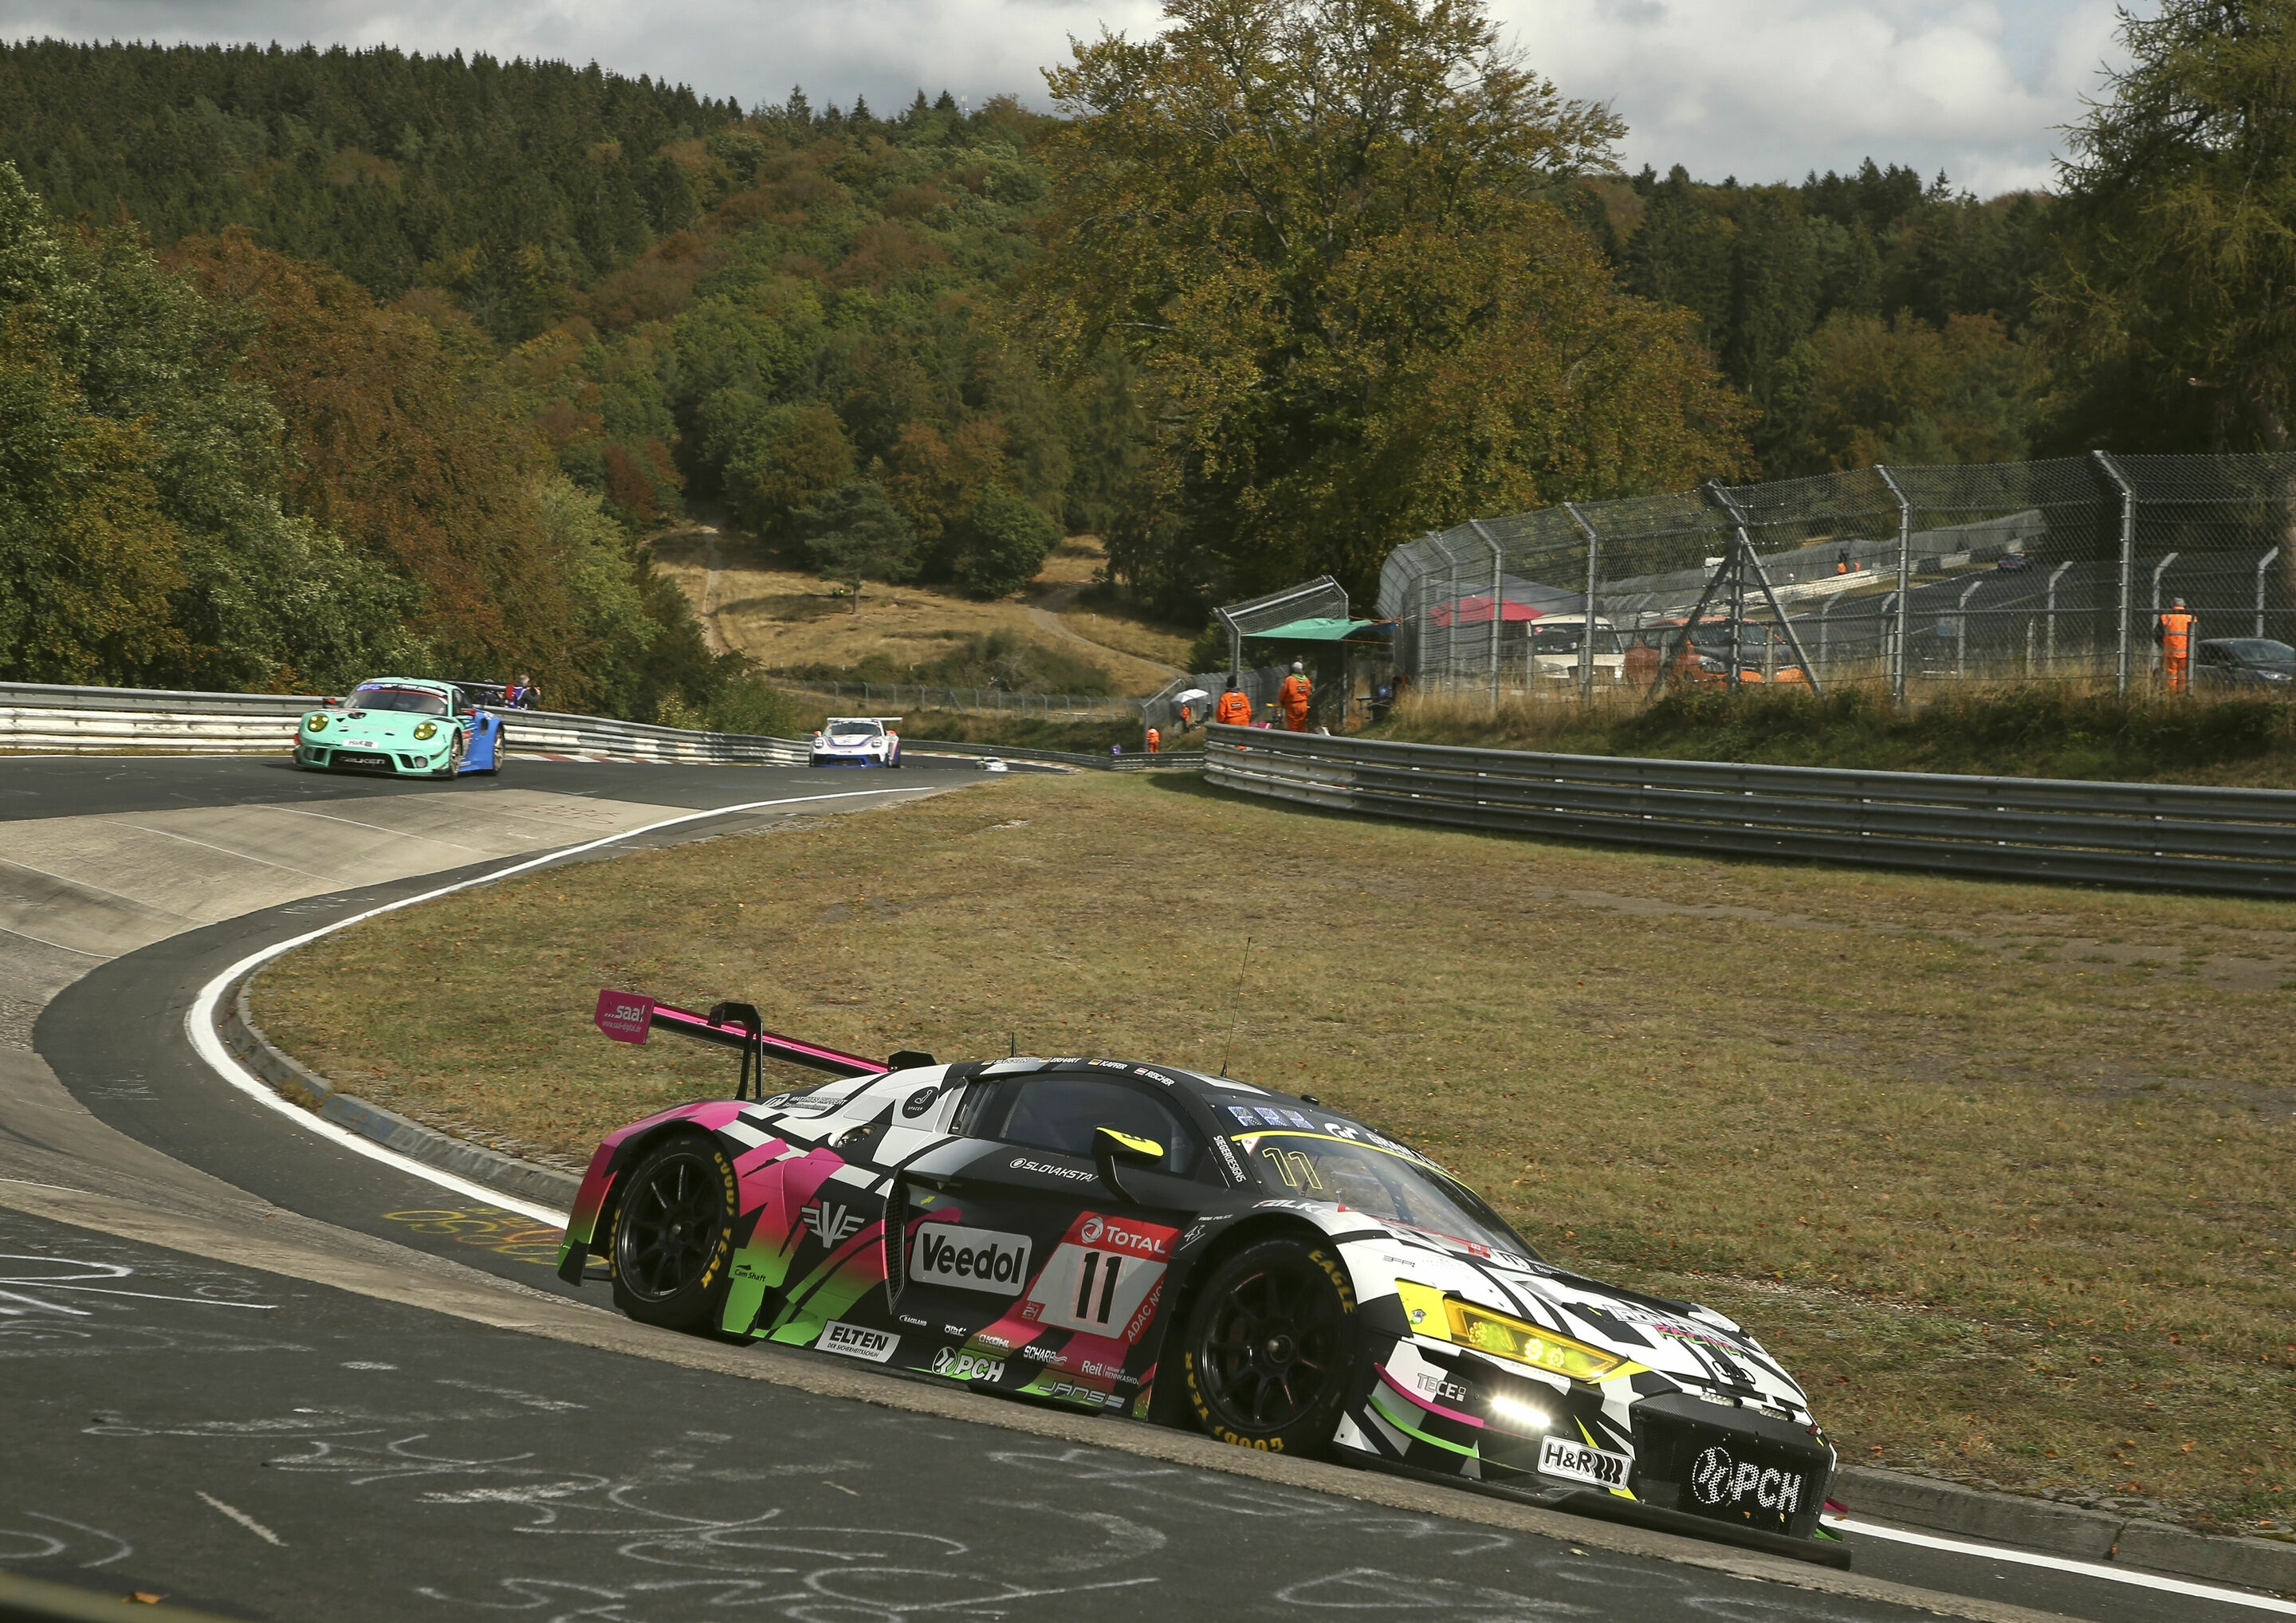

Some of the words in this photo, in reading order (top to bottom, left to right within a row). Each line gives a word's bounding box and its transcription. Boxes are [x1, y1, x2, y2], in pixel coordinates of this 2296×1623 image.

[1099, 1059, 1128, 1070] KAFFER
[1145, 1071, 1175, 1087] REICHER
[1213, 1135, 1247, 1183] SIEGERDESIGNS
[1262, 1147, 1323, 1189] 11
[1107, 1225, 1166, 1254] TOTAL
[922, 1232, 1025, 1285] Veedol
[734, 1269, 747, 1278] Cam
[748, 1271, 766, 1283] Shaft
[1075, 1251, 1123, 1325] 11
[1307, 1249, 1356, 1315] EAGLE
[1126, 1305, 1150, 1342] ADAC
[1149, 1279, 1165, 1307] NO
[829, 1326, 889, 1351] ELTEN
[953, 1354, 1005, 1382] PCH
[1081, 1360, 1103, 1377] Reil
[1544, 1444, 1592, 1474] H&R
[1732, 1460, 1801, 1513] PCH
